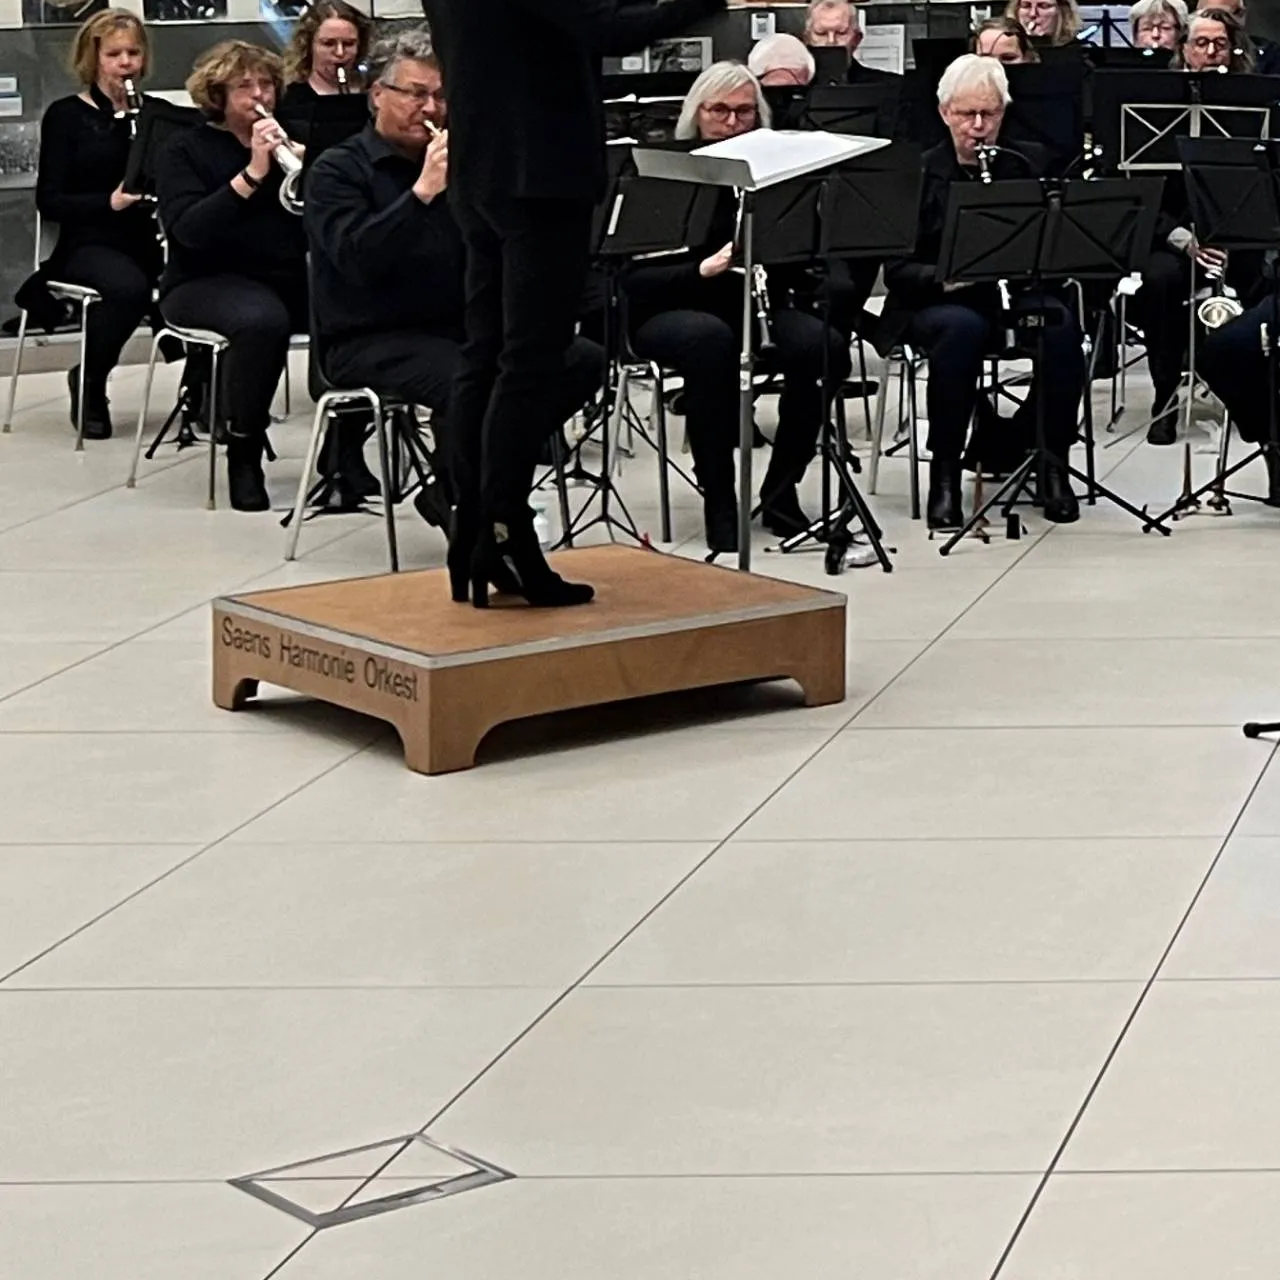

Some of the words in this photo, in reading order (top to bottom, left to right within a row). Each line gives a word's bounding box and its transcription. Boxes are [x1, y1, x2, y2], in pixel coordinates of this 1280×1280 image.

[221, 616, 271, 659] Saens
[280, 633, 355, 684] Harmonie
[364, 657, 419, 702] Orkest
